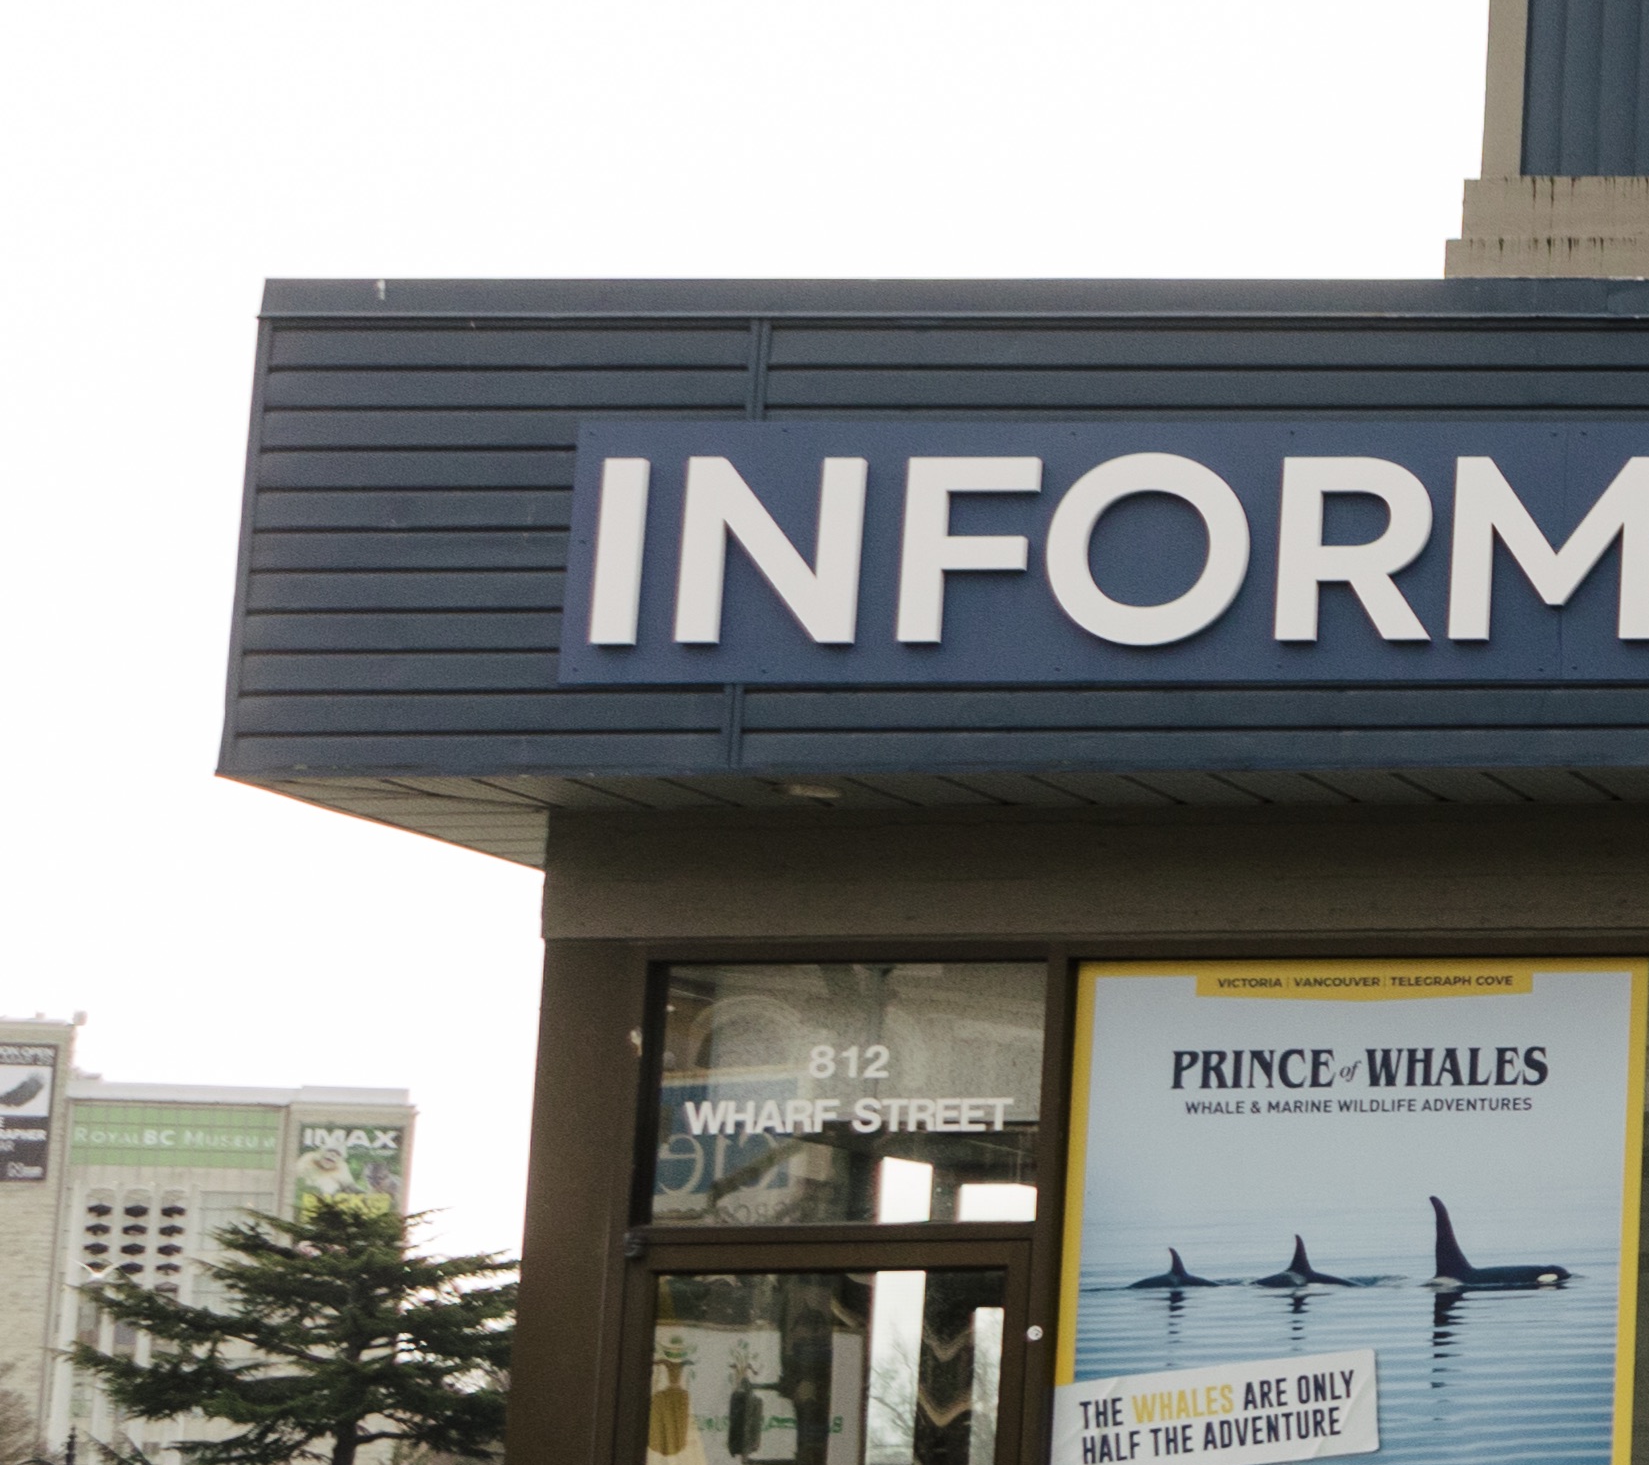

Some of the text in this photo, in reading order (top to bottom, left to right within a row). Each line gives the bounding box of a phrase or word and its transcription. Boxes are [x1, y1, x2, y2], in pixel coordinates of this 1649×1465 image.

[1218, 975, 1513, 989] VICTORIA VANCOUVER TELEGRAPH COVE
[808, 1044, 890, 1079] 812
[1171, 1046, 1549, 1089] PRINCE of WHALES
[684, 1096, 1014, 1135] WHARF STREET
[1185, 1097, 1532, 1114] WHALE & MARINE WILDLIFE ADVENTURES
[144, 1129, 176, 1147] BC
[303, 1128, 400, 1149] IMAX
[1080, 1370, 1354, 1430] THE WHALES ARE ONLY
[1082, 1406, 1342, 1465] HALF THE ADVENTURE
